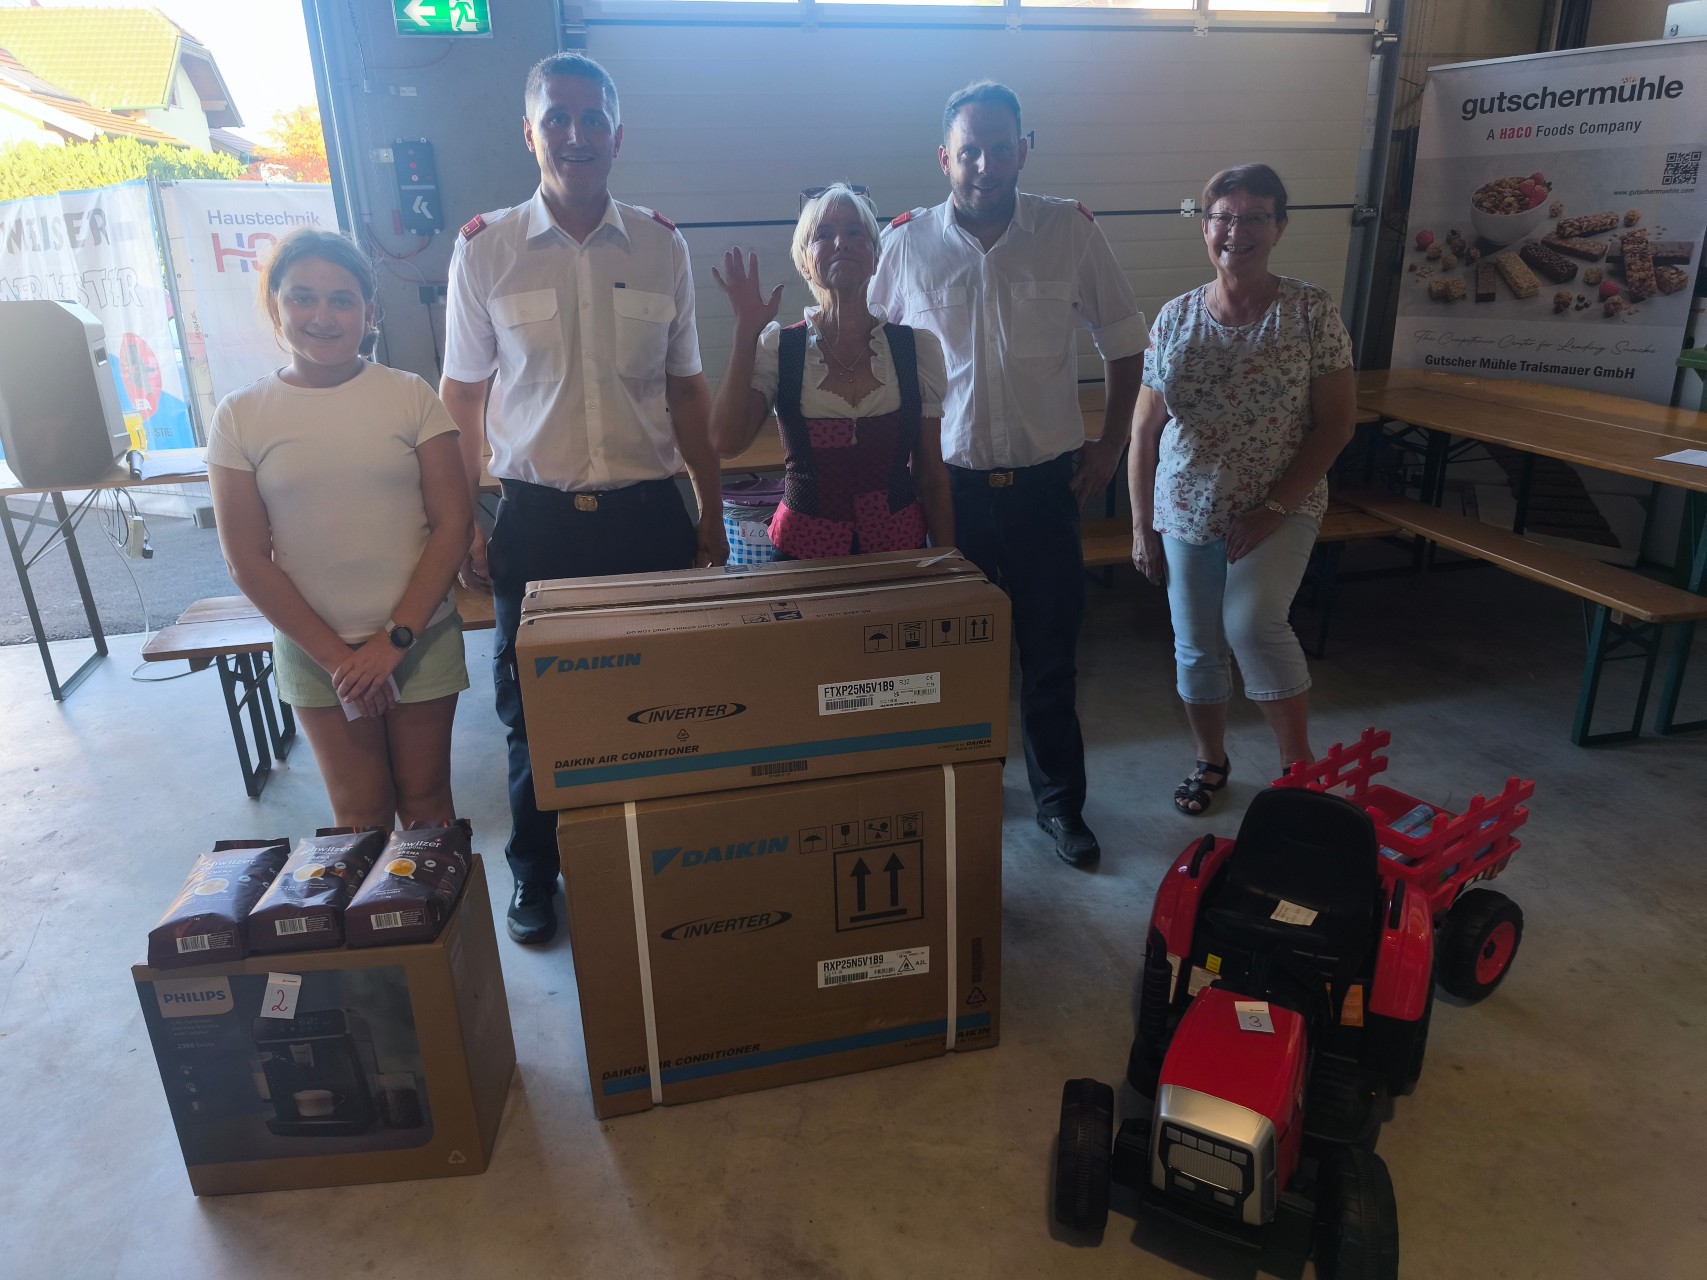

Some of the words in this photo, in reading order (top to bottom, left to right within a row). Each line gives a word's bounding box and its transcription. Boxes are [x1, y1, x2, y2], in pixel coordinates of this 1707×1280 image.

[1462, 75, 1683, 120] gutschermühle
[1487, 129, 1495, 141] A
[1536, 122, 1574, 137] Foods
[1579, 120, 1642, 135] Company
[207, 209, 322, 227] Haustechnik
[1537, 338, 1552, 350] for
[1425, 354, 1477, 368] Gutscher
[1479, 358, 1517, 371] Mühle
[1520, 361, 1590, 376] Traismauer
[1593, 366, 1635, 379] GmbH
[557, 653, 641, 673] DAIKIN
[824, 681, 895, 698] FTXP25N5V1B9
[648, 702, 729, 722] INVERTER
[554, 759, 597, 769] DAIKIN
[599, 754, 618, 765] AIR
[622, 743, 699, 762] CONDITIONER
[681, 836, 789, 868] DAIKIN
[684, 912, 770, 939] INVERTER
[823, 955, 884, 972] RXP25N5V1B9
[163, 990, 226, 1004] PHILIPS
[272, 989, 288, 1012] 2
[1249, 1015, 1262, 1028] 3
[957, 1026, 991, 1038] AIKIN
[601, 1065, 647, 1081] DAIKIN
[674, 1043, 761, 1068] CONDITIONER
